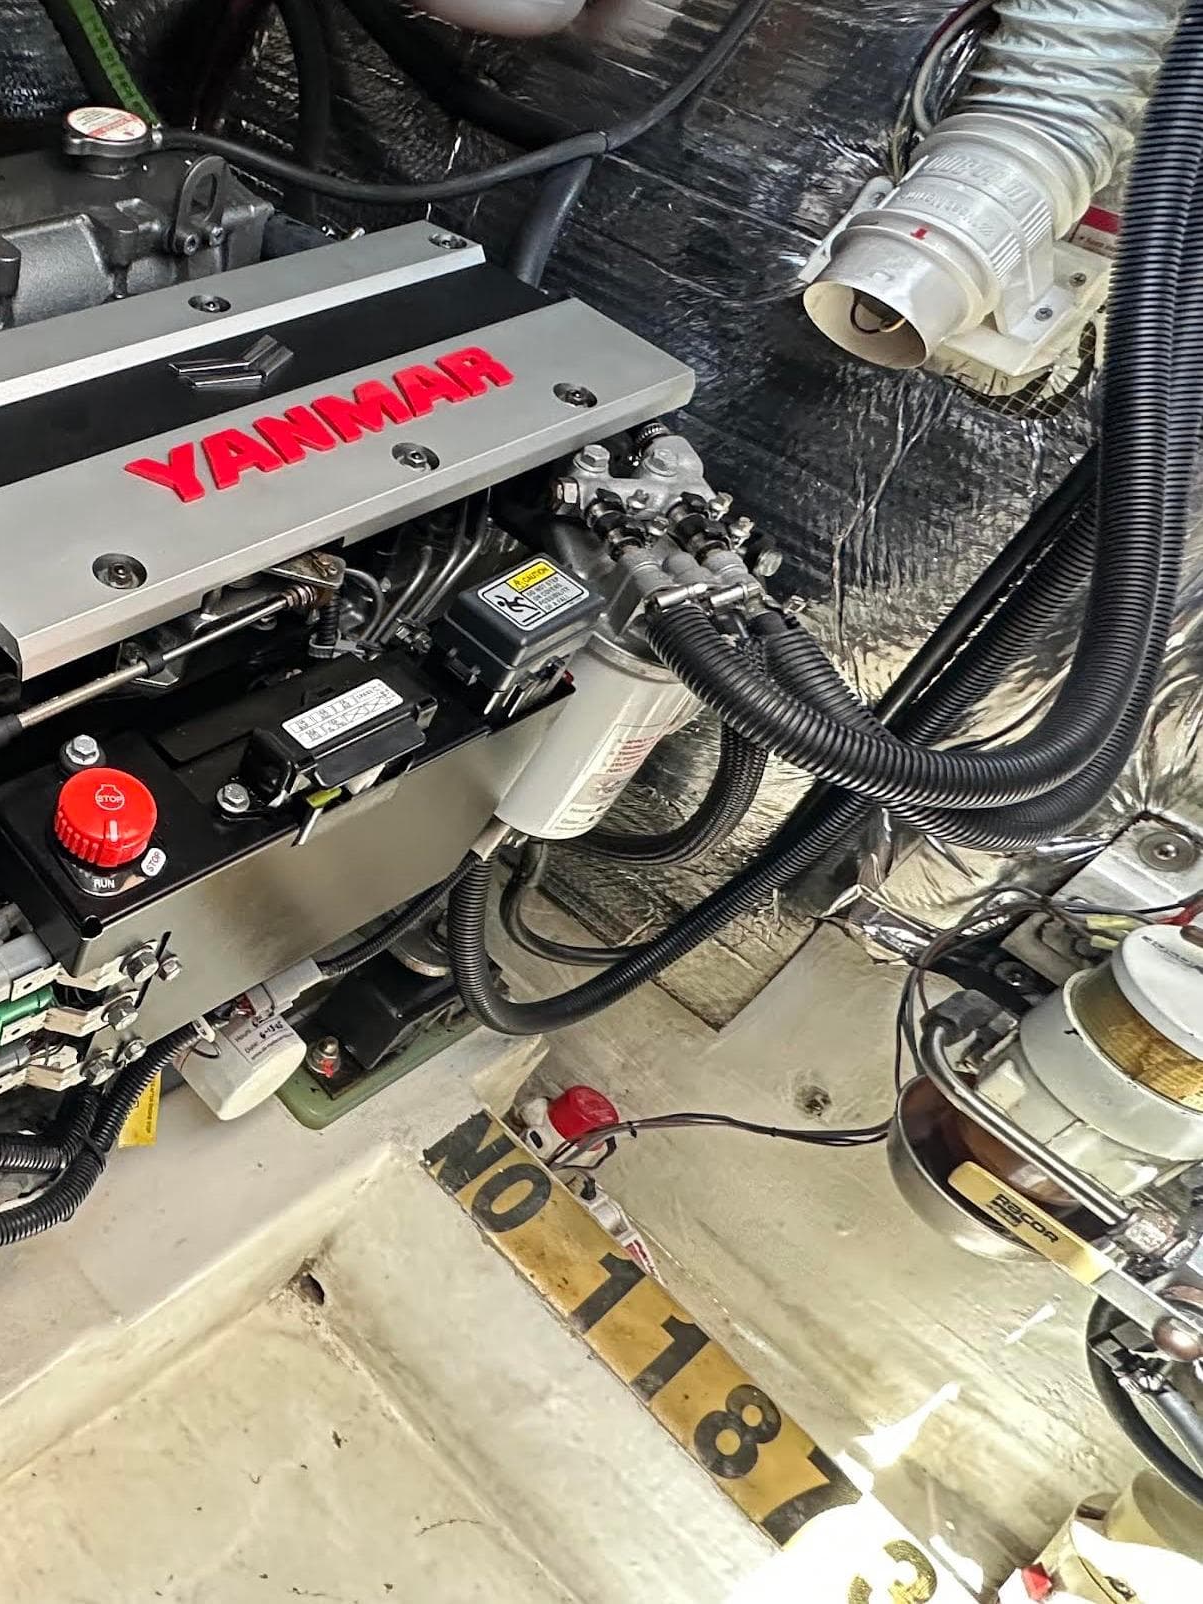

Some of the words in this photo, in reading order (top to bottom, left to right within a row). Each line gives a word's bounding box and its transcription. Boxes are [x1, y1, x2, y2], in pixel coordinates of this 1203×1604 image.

[124, 346, 515, 503] YANMAR
[96, 795, 125, 803] STOP
[146, 851, 160, 873] STOP
[93, 879, 116, 889] RUN
